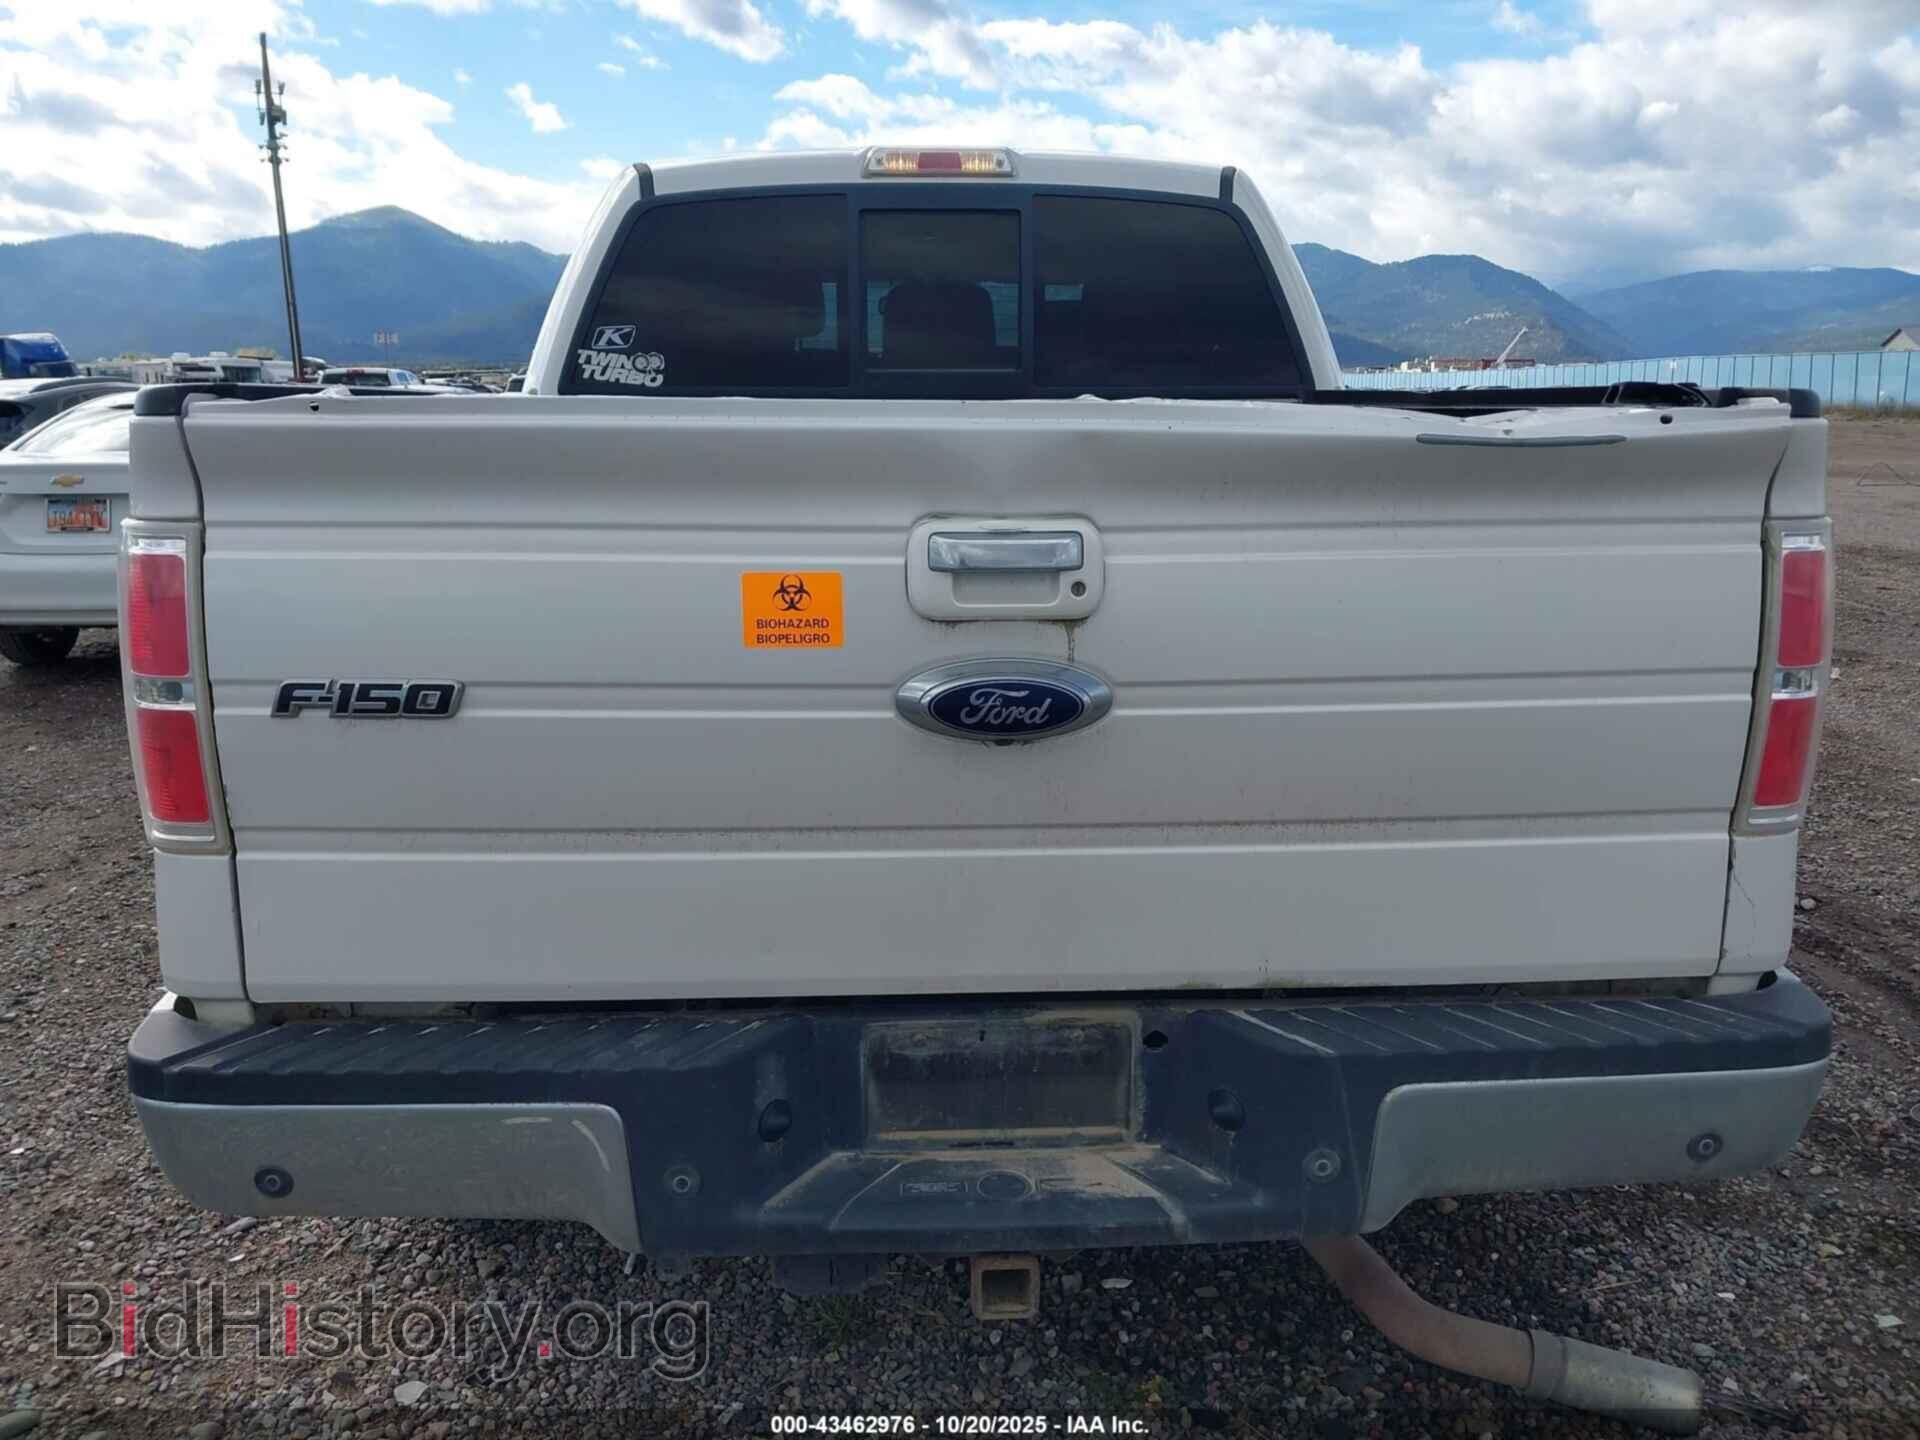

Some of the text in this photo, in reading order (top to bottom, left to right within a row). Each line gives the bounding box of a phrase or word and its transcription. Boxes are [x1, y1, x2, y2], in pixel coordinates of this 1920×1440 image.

[577, 349, 632, 370] TWIN
[582, 364, 665, 387] TURBO
[756, 618, 830, 629] BIOHAZARD
[756, 633, 831, 644] BIOPELIGRO
[271, 680, 465, 718] F-150
[959, 687, 1053, 725] Ford
